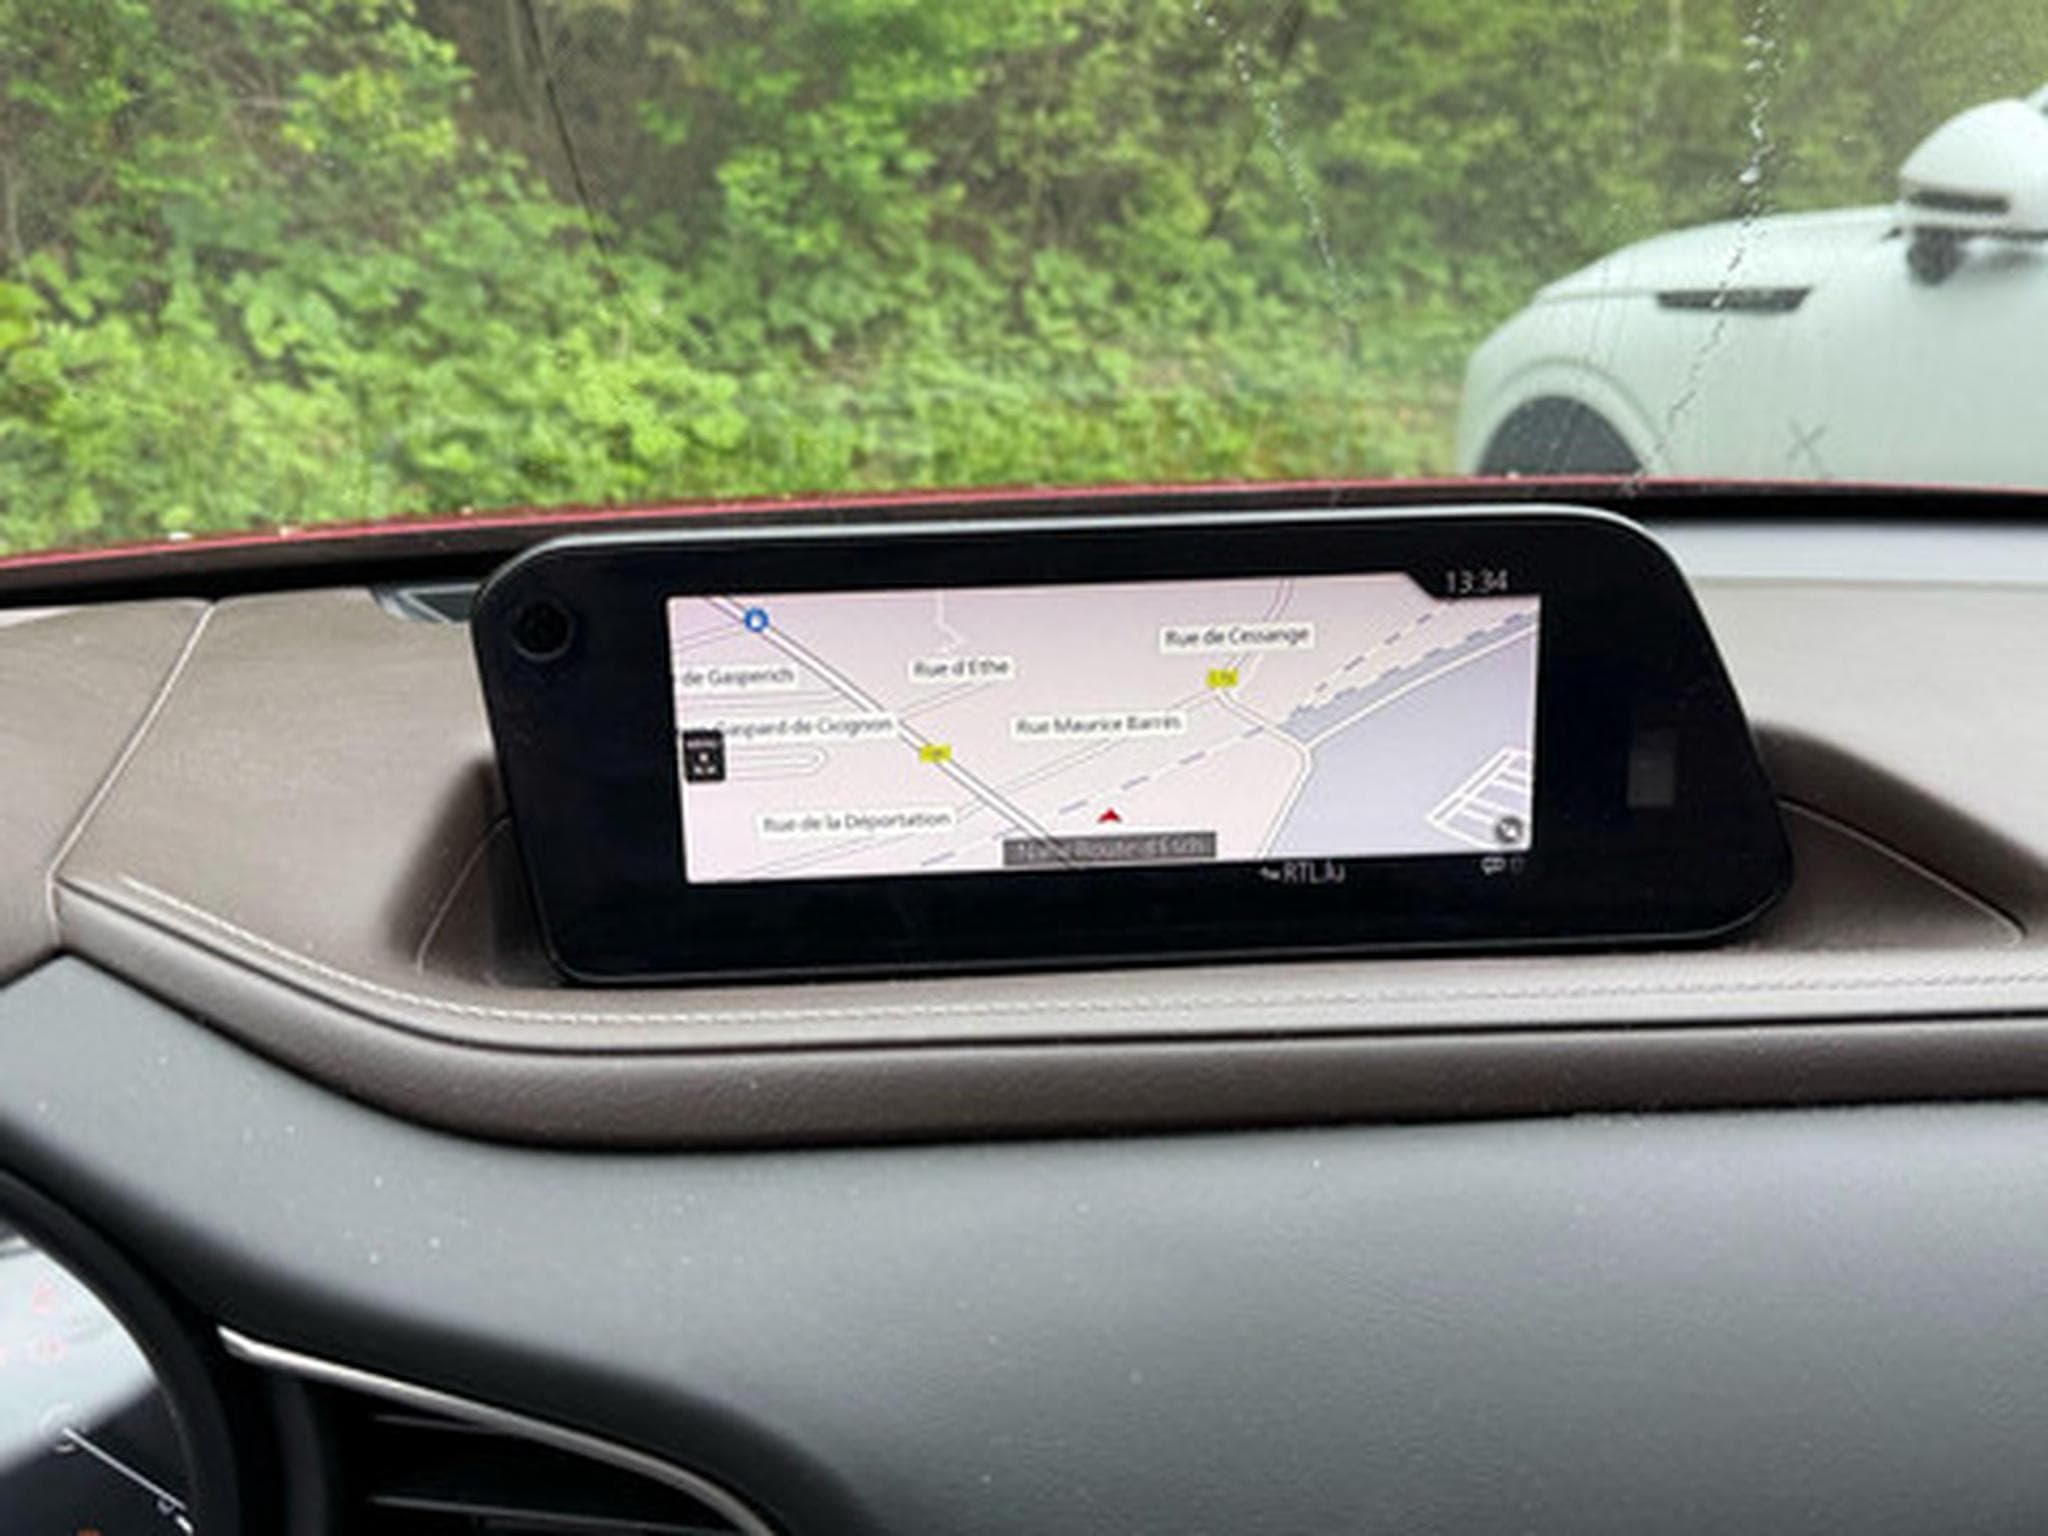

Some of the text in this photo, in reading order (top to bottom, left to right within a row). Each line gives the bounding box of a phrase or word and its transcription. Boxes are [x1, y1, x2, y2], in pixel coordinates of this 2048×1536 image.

[1446, 569, 1508, 594] 13:34
[1165, 626, 1309, 646] Rue de Cessange
[682, 667, 795, 688] de Gasperich
[913, 660, 948, 678] Rue
[792, 716, 811, 736] de
[1016, 717, 1049, 734] Rue
[1053, 716, 1122, 734] Maurice
[763, 816, 796, 833] Rue
[801, 813, 821, 832] de
[826, 812, 841, 831] la
